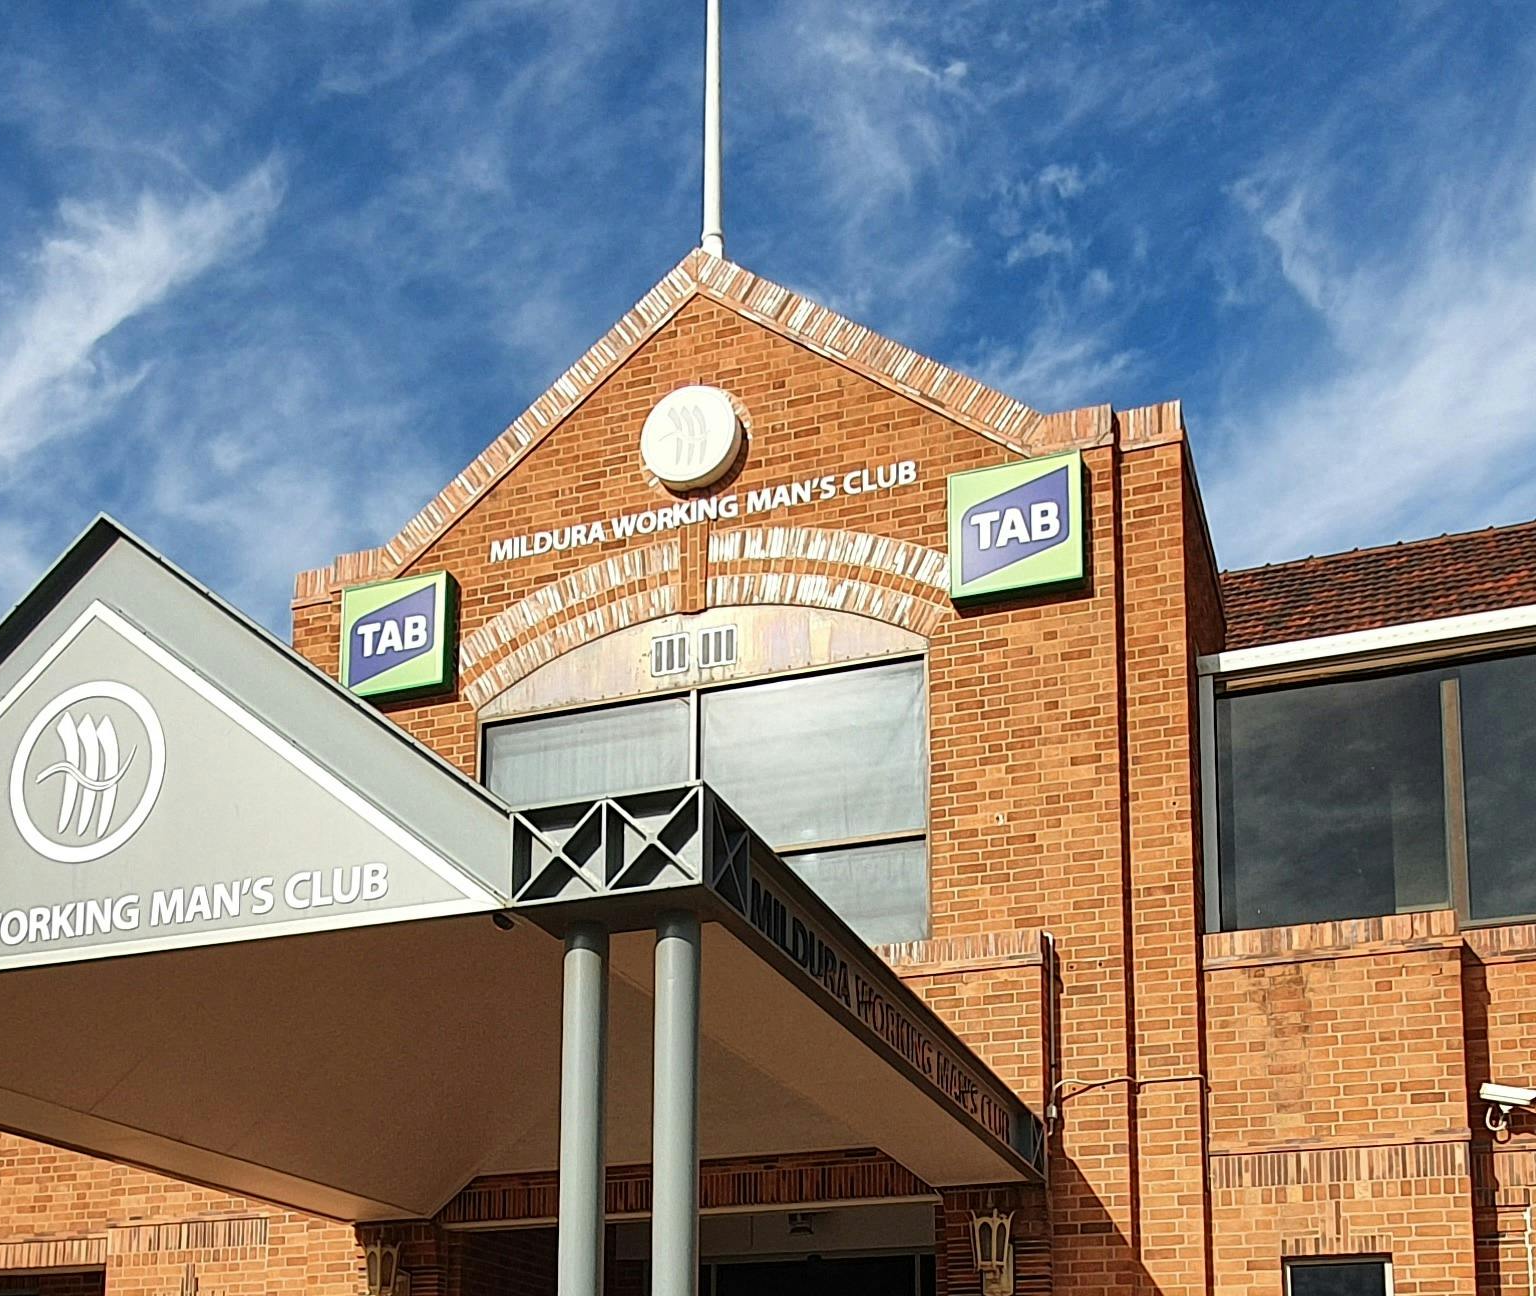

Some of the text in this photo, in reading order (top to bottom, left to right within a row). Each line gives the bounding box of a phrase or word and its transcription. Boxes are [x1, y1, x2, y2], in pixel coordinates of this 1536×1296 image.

[489, 460, 917, 563] MILDURA WORKING MAN'S CLUB
[970, 502, 1061, 550] TAB
[357, 615, 428, 657] TAB
[150, 876, 274, 926] MAN'S
[284, 862, 389, 908] CLUB
[750, 878, 851, 1008] MILDURA
[855, 973, 933, 1077] WORKING
